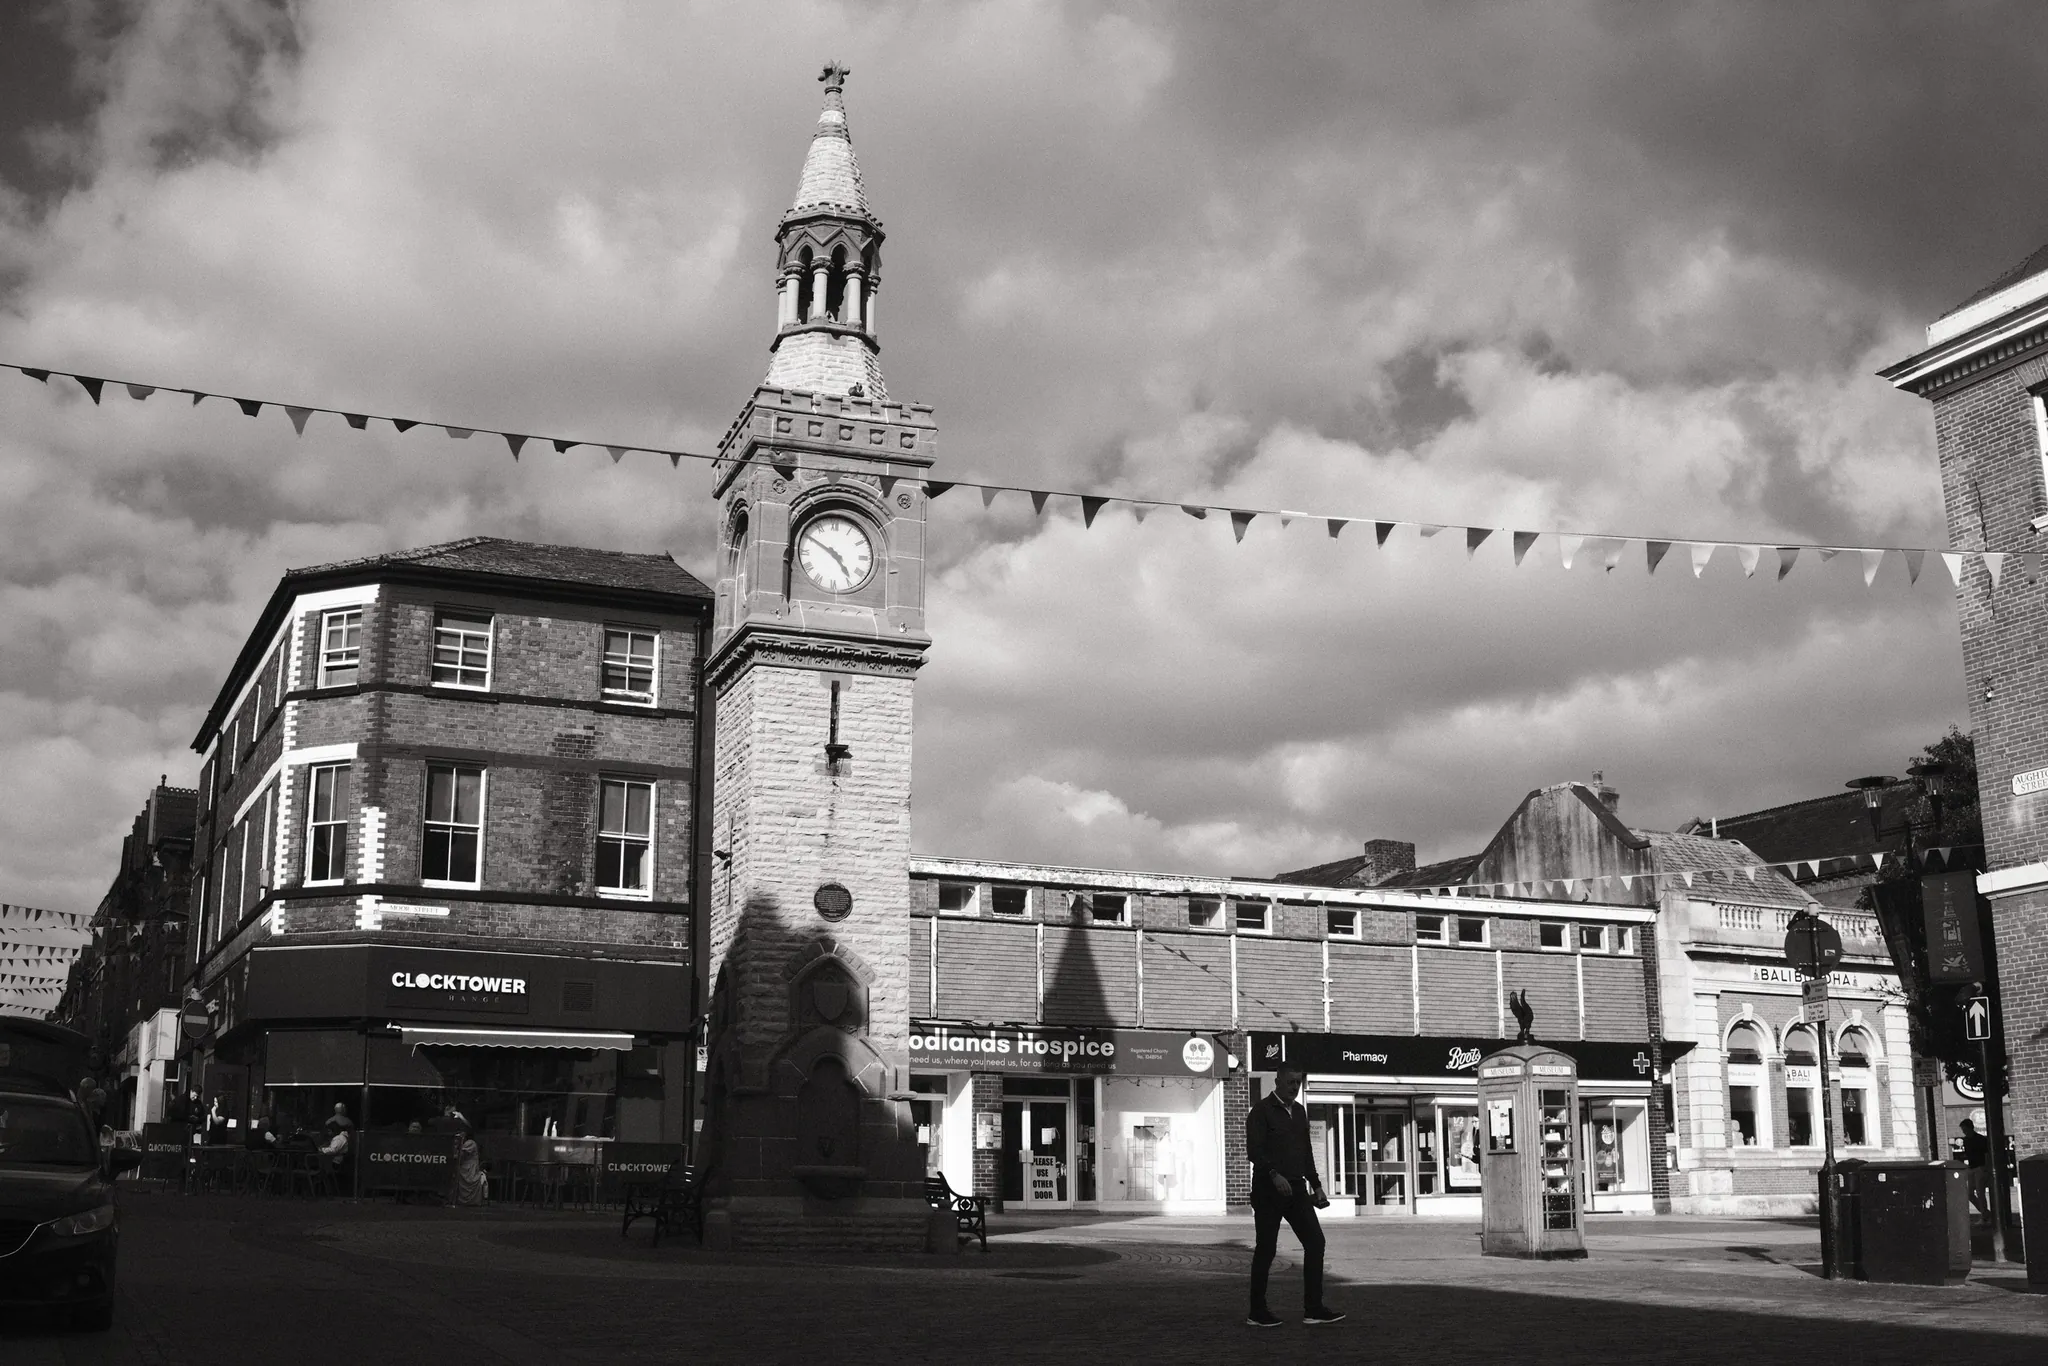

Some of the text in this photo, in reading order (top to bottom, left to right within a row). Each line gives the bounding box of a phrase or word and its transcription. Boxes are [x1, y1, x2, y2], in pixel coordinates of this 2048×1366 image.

[2020, 779, 2048, 792] STREE
[391, 972, 526, 994] CLOCKTOWER
[909, 1027, 1115, 1062] odlands Hospice
[909, 1055, 930, 1064] need
[944, 1056, 968, 1065] where
[970, 1058, 984, 1067] you
[986, 1058, 1006, 1066] need
[1020, 1058, 1031, 1067] for
[1342, 1051, 1388, 1064] Pharmacy
[1445, 1046, 1481, 1070] Boots
[1490, 1067, 1515, 1075] MUSEUM
[1791, 1069, 1810, 1077] BALI
[149, 1143, 182, 1152] CLOCKTOWER
[369, 1153, 447, 1164] CLOCKTOWER
[1032, 1157, 1054, 1166] PLEASE
[1036, 1169, 1049, 1177] USE
[1032, 1180, 1054, 1188] OTHER
[1034, 1191, 1054, 1199] DOOR
